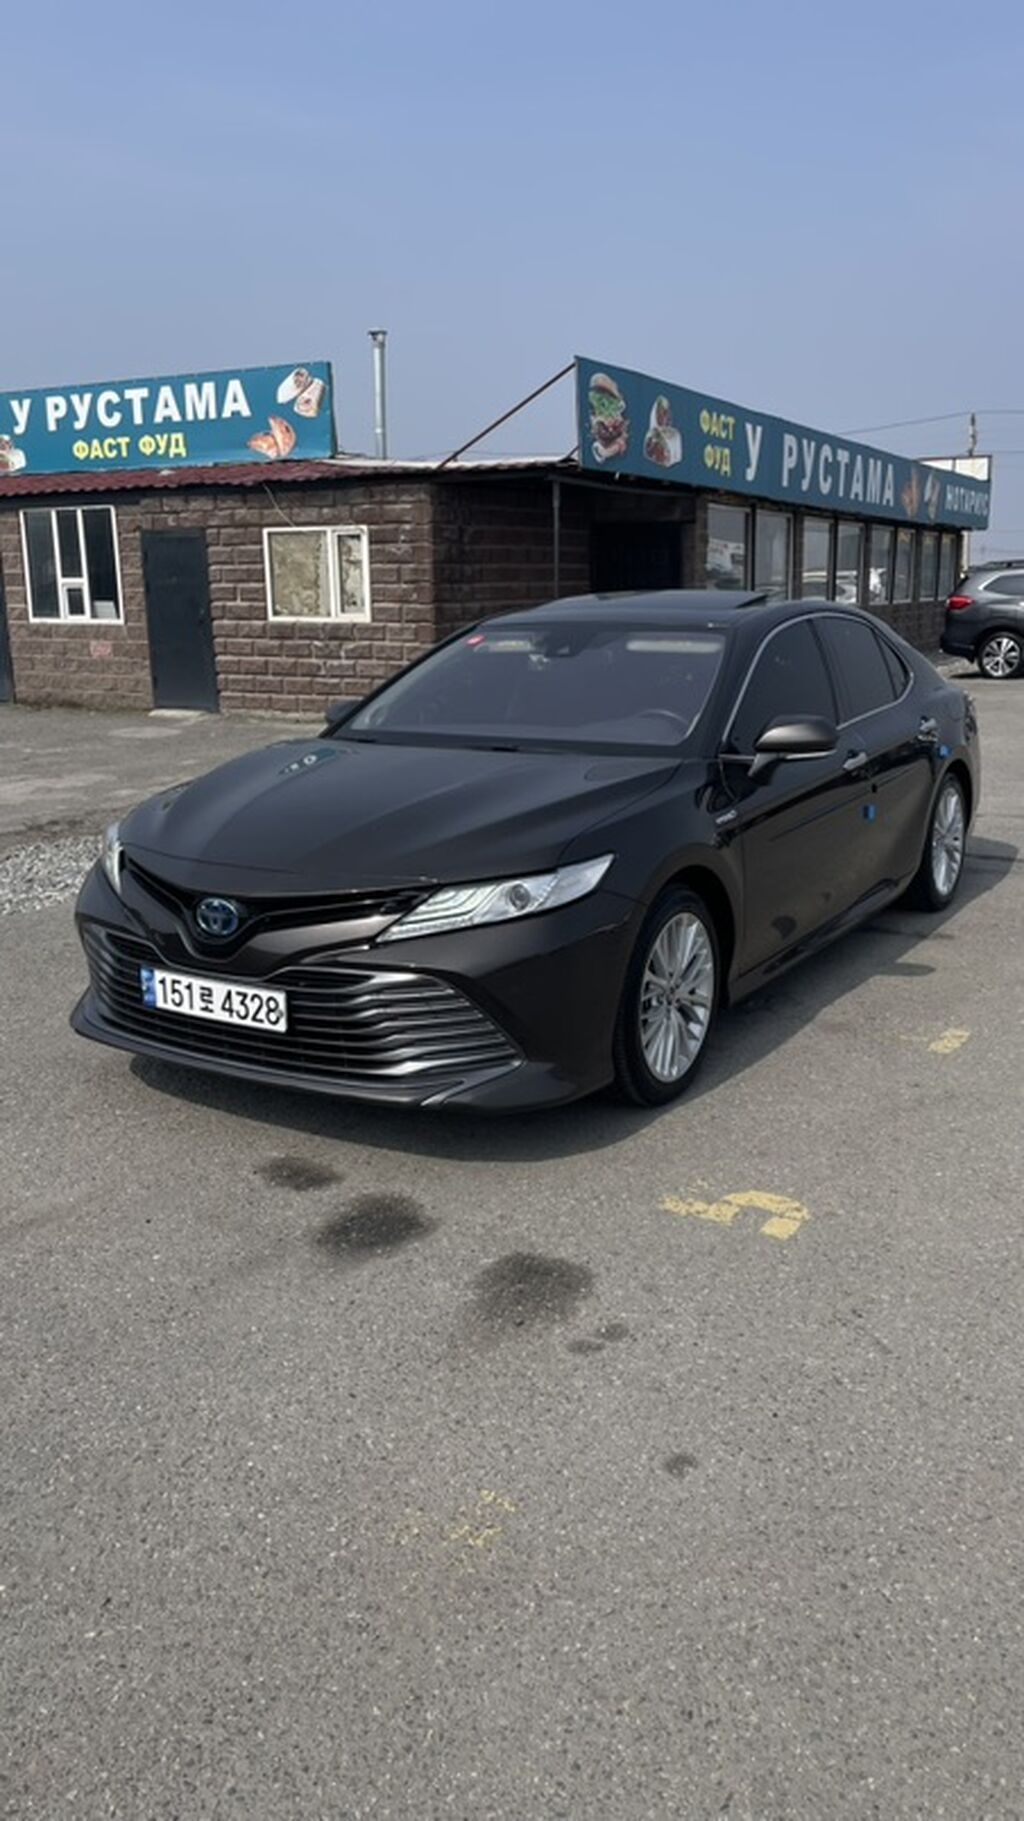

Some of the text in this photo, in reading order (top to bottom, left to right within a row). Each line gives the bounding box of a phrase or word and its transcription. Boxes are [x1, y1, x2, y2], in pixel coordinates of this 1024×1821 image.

[10, 379, 251, 434] У РУСТАМА
[701, 409, 735, 440] ФАСТ
[72, 432, 187, 460] ФАСТ ФУД
[704, 444, 731, 477] ФУД
[745, 422, 894, 506] У РУСТАМА
[158, 976, 281, 1025] 151로 4328
